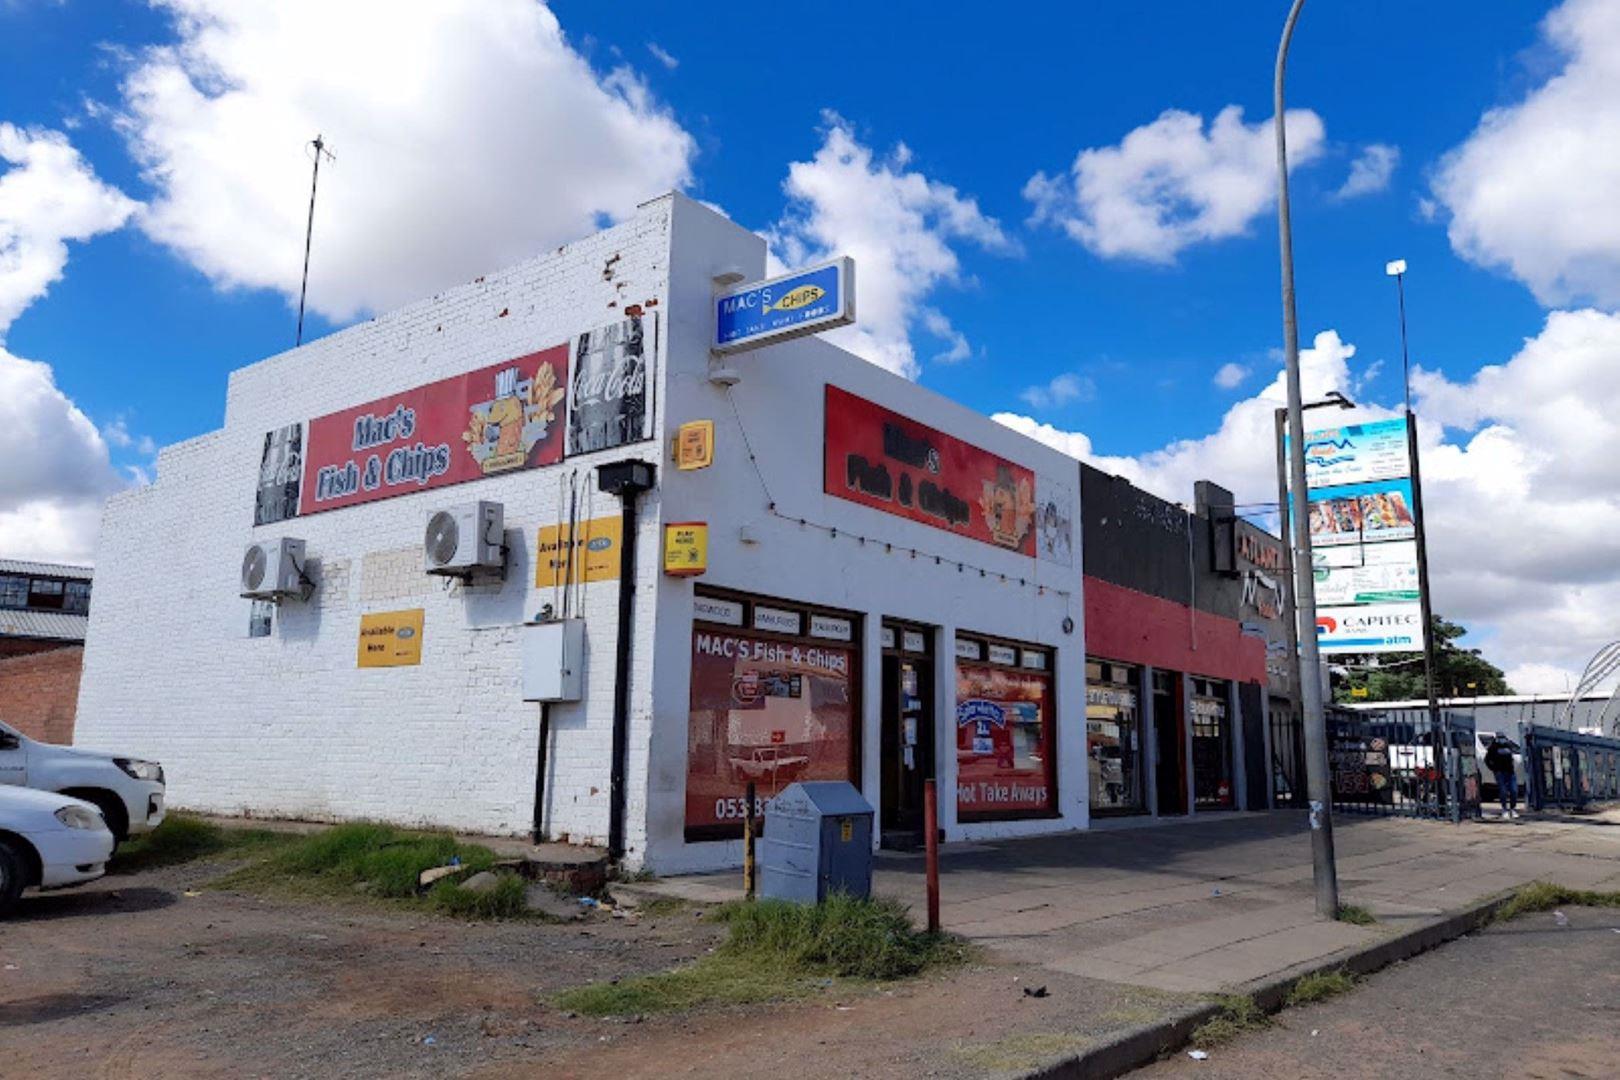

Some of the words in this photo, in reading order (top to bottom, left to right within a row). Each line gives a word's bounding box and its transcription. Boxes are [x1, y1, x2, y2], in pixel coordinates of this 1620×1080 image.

[723, 288, 772, 314] MAC'S
[782, 287, 819, 308] CHIPS
[352, 404, 416, 452] Mac's
[315, 460, 360, 502] Fish
[362, 454, 383, 492] &
[385, 442, 451, 486] Chips
[1343, 614, 1418, 627] CAPITEC
[697, 634, 749, 660] MAC'S
[754, 641, 786, 663] Fish
[791, 646, 801, 664] &
[807, 648, 845, 671] Chips
[1385, 635, 1412, 645] atm
[980, 783, 1009, 803] Take
[1011, 783, 1048, 806] Aways
